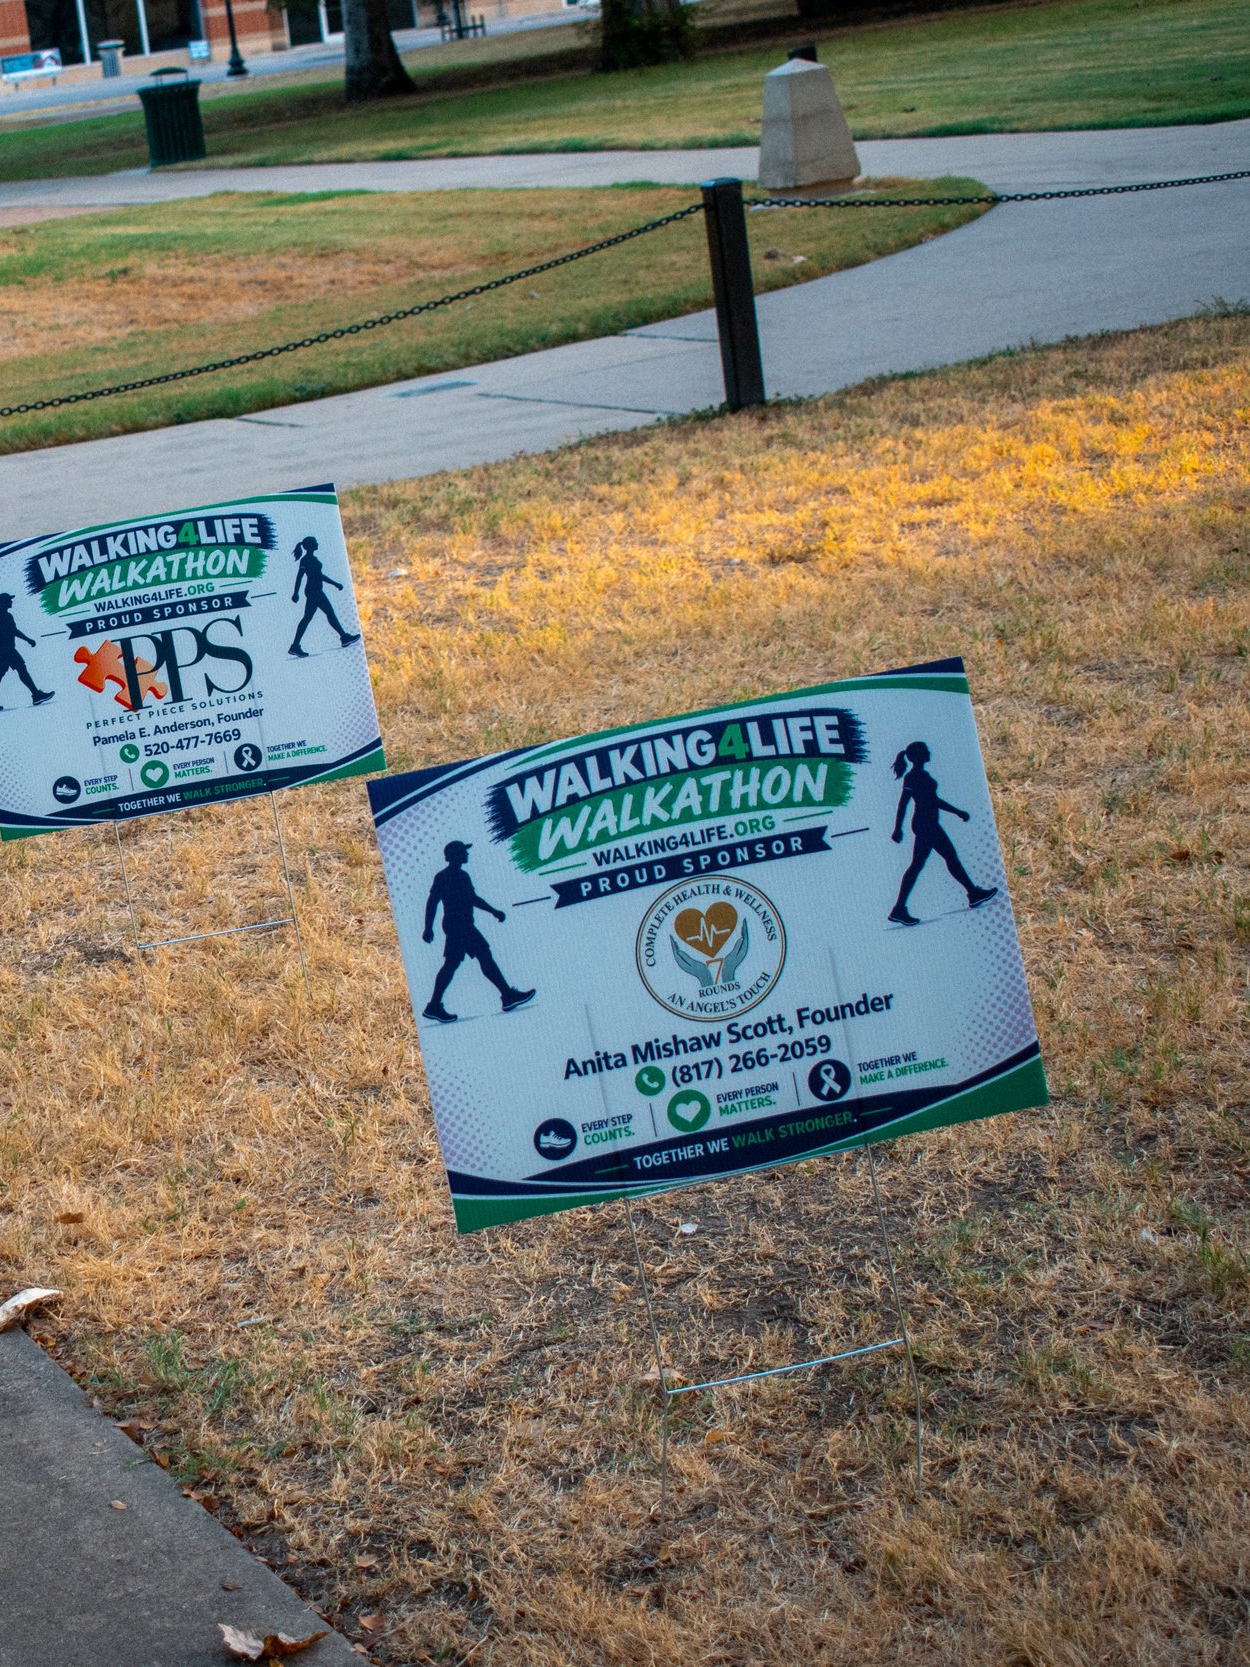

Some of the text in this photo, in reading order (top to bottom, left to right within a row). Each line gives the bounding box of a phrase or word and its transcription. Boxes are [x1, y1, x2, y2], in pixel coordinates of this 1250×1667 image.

[37, 517, 262, 583] WALKING4LIFE
[58, 548, 250, 608] WALKATHON
[86, 597, 233, 632] PROUD SPONSOR
[94, 582, 215, 613] WALKING4LIFE.ORG
[111, 615, 253, 713] PPS
[86, 691, 264, 729] PERFECT PIECE SOLUTIONS
[93, 707, 264, 746] Pamela E. Anderson, Founder
[144, 728, 241, 757] 520-477-7669
[266, 739, 306, 753] TOGETHER WE
[268, 744, 328, 762] MAKE A DIFFERENCE.
[84, 774, 118, 786] EVERY STEP
[173, 757, 215, 771] EVERY PERSON
[174, 766, 213, 779] MATTERS.
[505, 715, 845, 824] WALKING4LIFE
[85, 781, 120, 795] COUNTS.
[118, 778, 267, 812] TOGETHER WE WALK STRONGER.
[538, 762, 828, 860] WALKATHON
[592, 815, 776, 867] WALKING4LIFE.ORG
[580, 836, 804, 897] PROUD SPONSOR
[645, 884, 777, 967] COMPLETE HEALTH & WELLNESS
[667, 971, 771, 1013] AN ANGEL'S TOUCH
[698, 982, 741, 998] ROUNDS
[563, 991, 894, 1080] Anita Mishaw Scott, Founder
[671, 1034, 832, 1088] (817) 266-2059
[857, 1051, 917, 1072] TOGETHER WE
[859, 1058, 948, 1085] MAKE A DIFFERENCE.
[716, 1082, 778, 1104] EVERY PERSON
[718, 1097, 776, 1117] MATTERS.
[581, 1114, 633, 1134] EVERY STEP
[584, 1125, 635, 1146] COUNTS.
[633, 1112, 858, 1170] TOGETHER WE WALK STRONGER.
